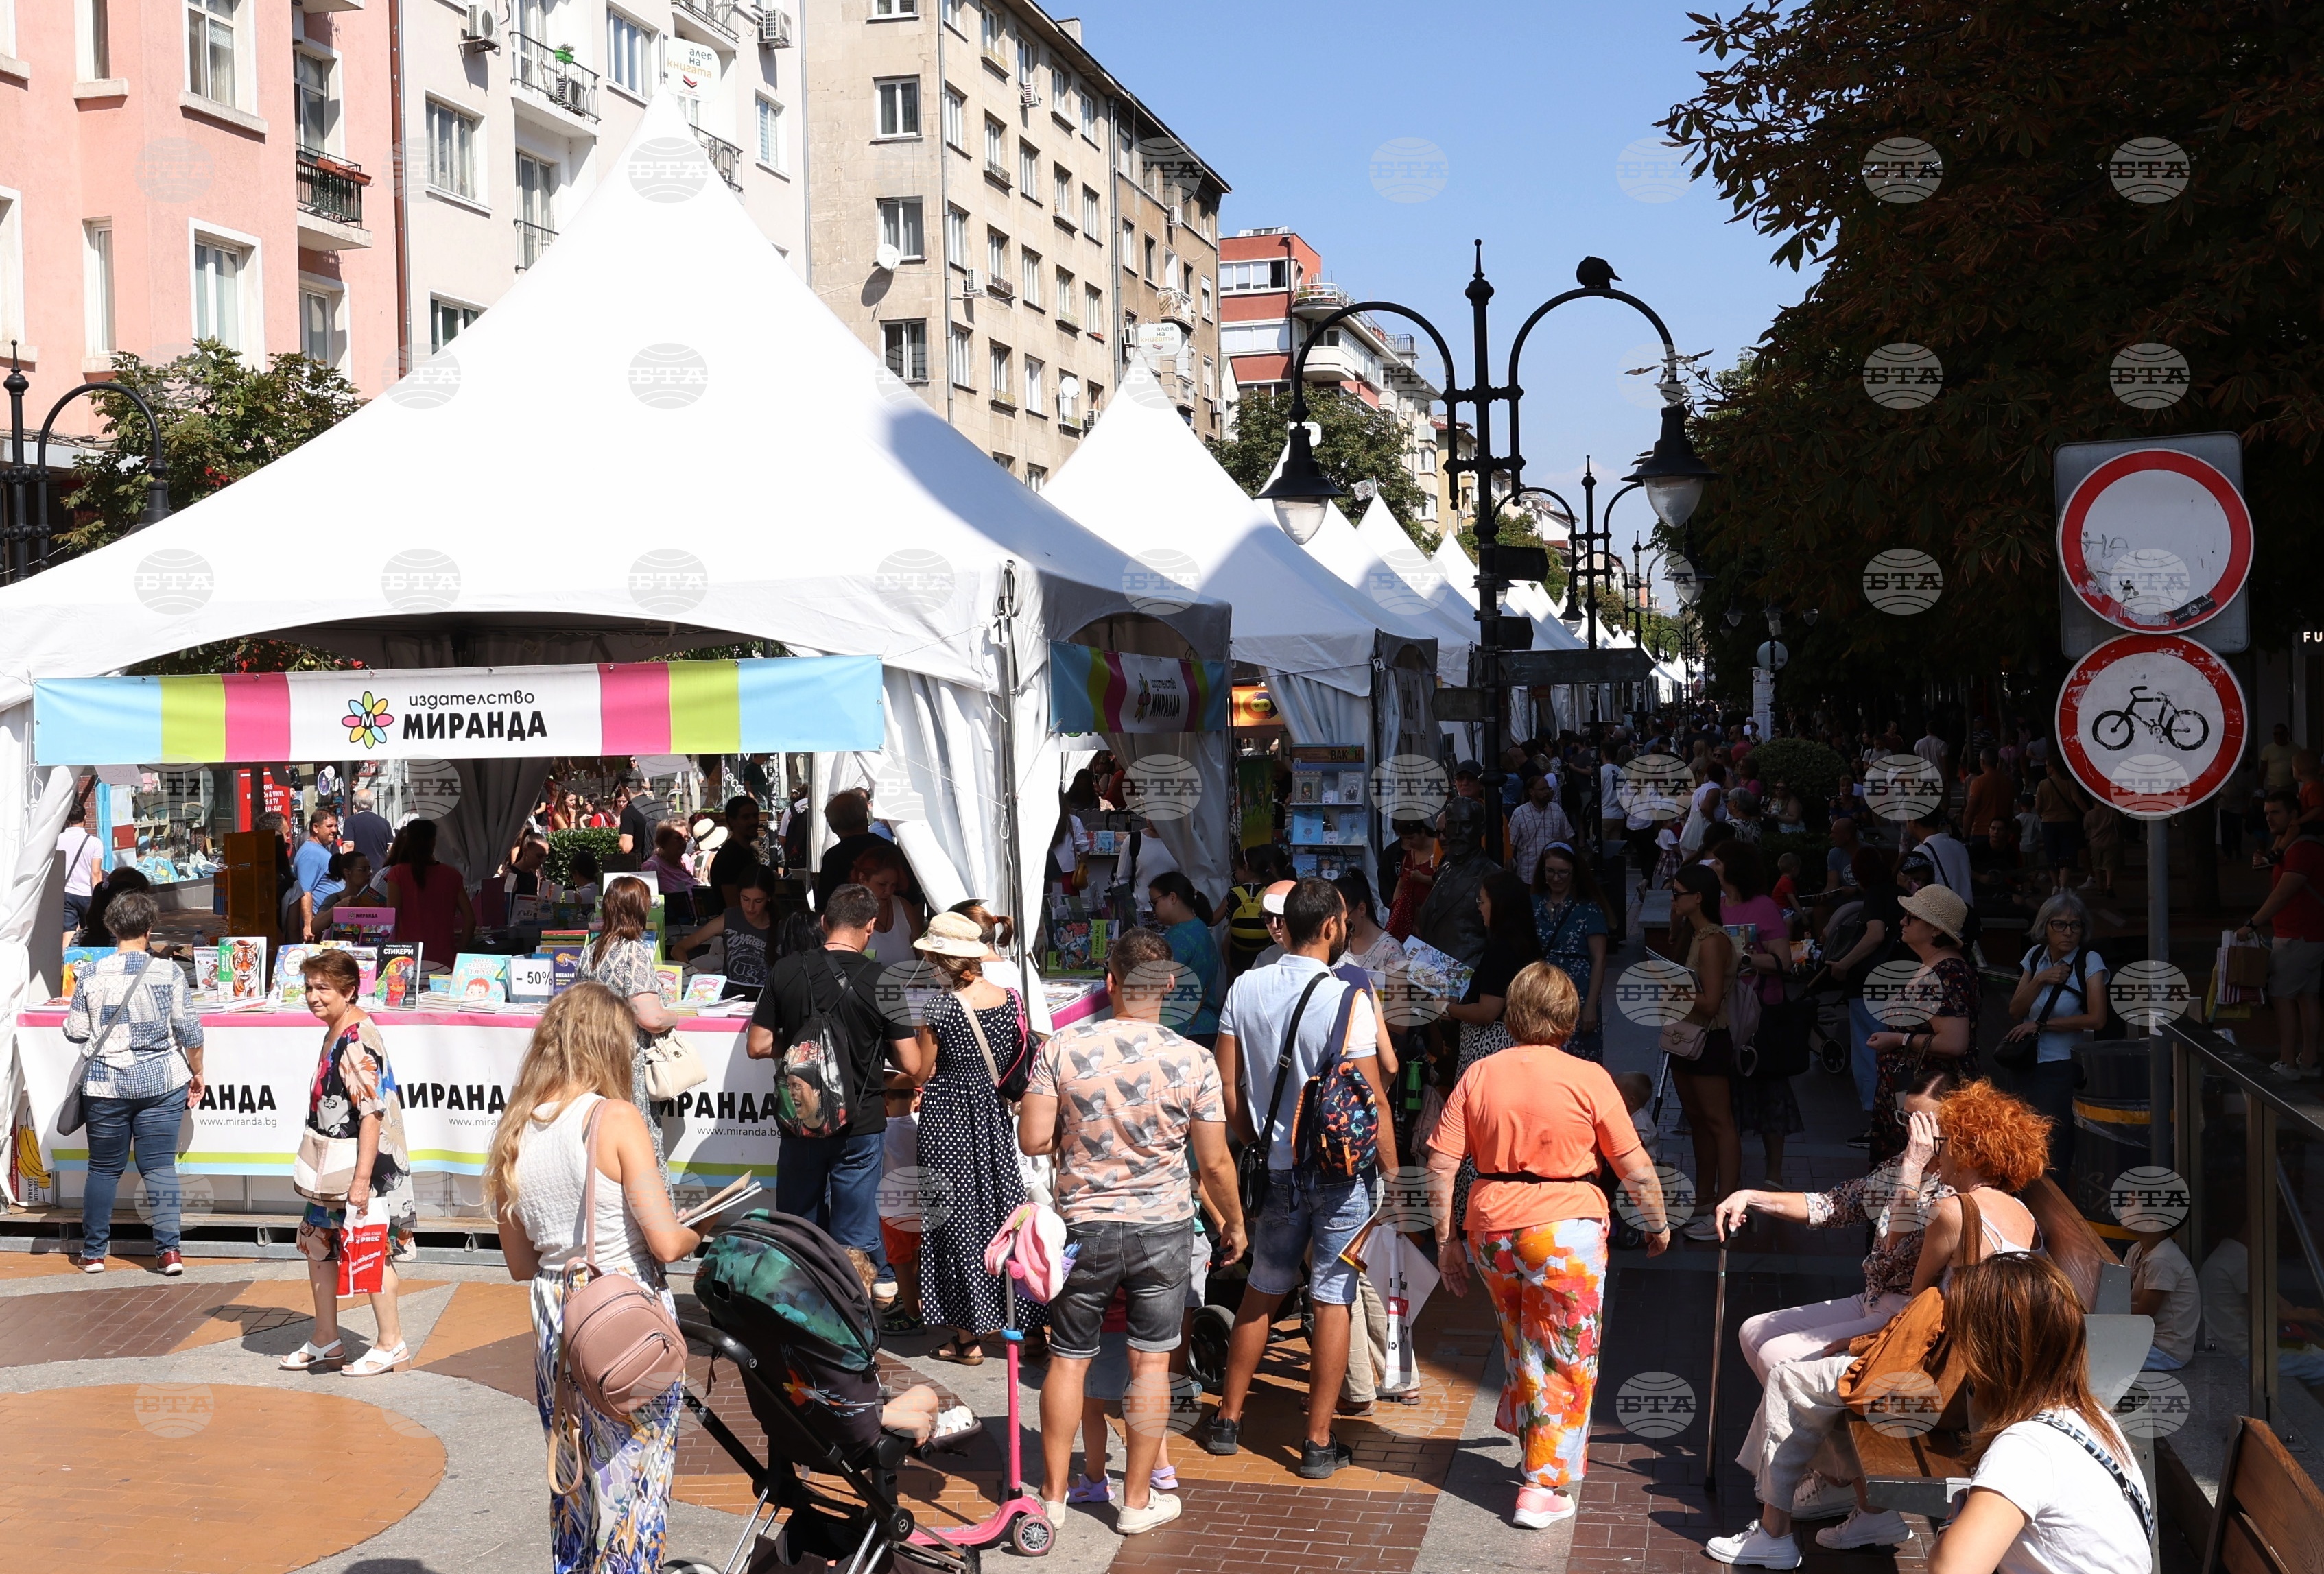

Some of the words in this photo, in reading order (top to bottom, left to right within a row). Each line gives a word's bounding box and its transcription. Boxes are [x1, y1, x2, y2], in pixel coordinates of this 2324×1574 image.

[689, 48, 712, 62] алея
[689, 56, 701, 67] на
[667, 57, 712, 78] книгата
[993, 619, 1003, 643] 1
[1469, 643, 1474, 652] 3
[1375, 659, 1383, 671] 2
[409, 690, 535, 710] издателство
[1149, 693, 1180, 720] МИРАНДА
[403, 711, 547, 741] МИРАНДА
[527, 971, 553, 986] 50%
[199, 1084, 277, 1114] АНДА
[396, 1082, 507, 1114] ИРАНД
[659, 1091, 779, 1124] ИРАНДА
[200, 1117, 277, 1128] www.miranda.bg
[697, 1127, 781, 1138] www.miranda.bg
